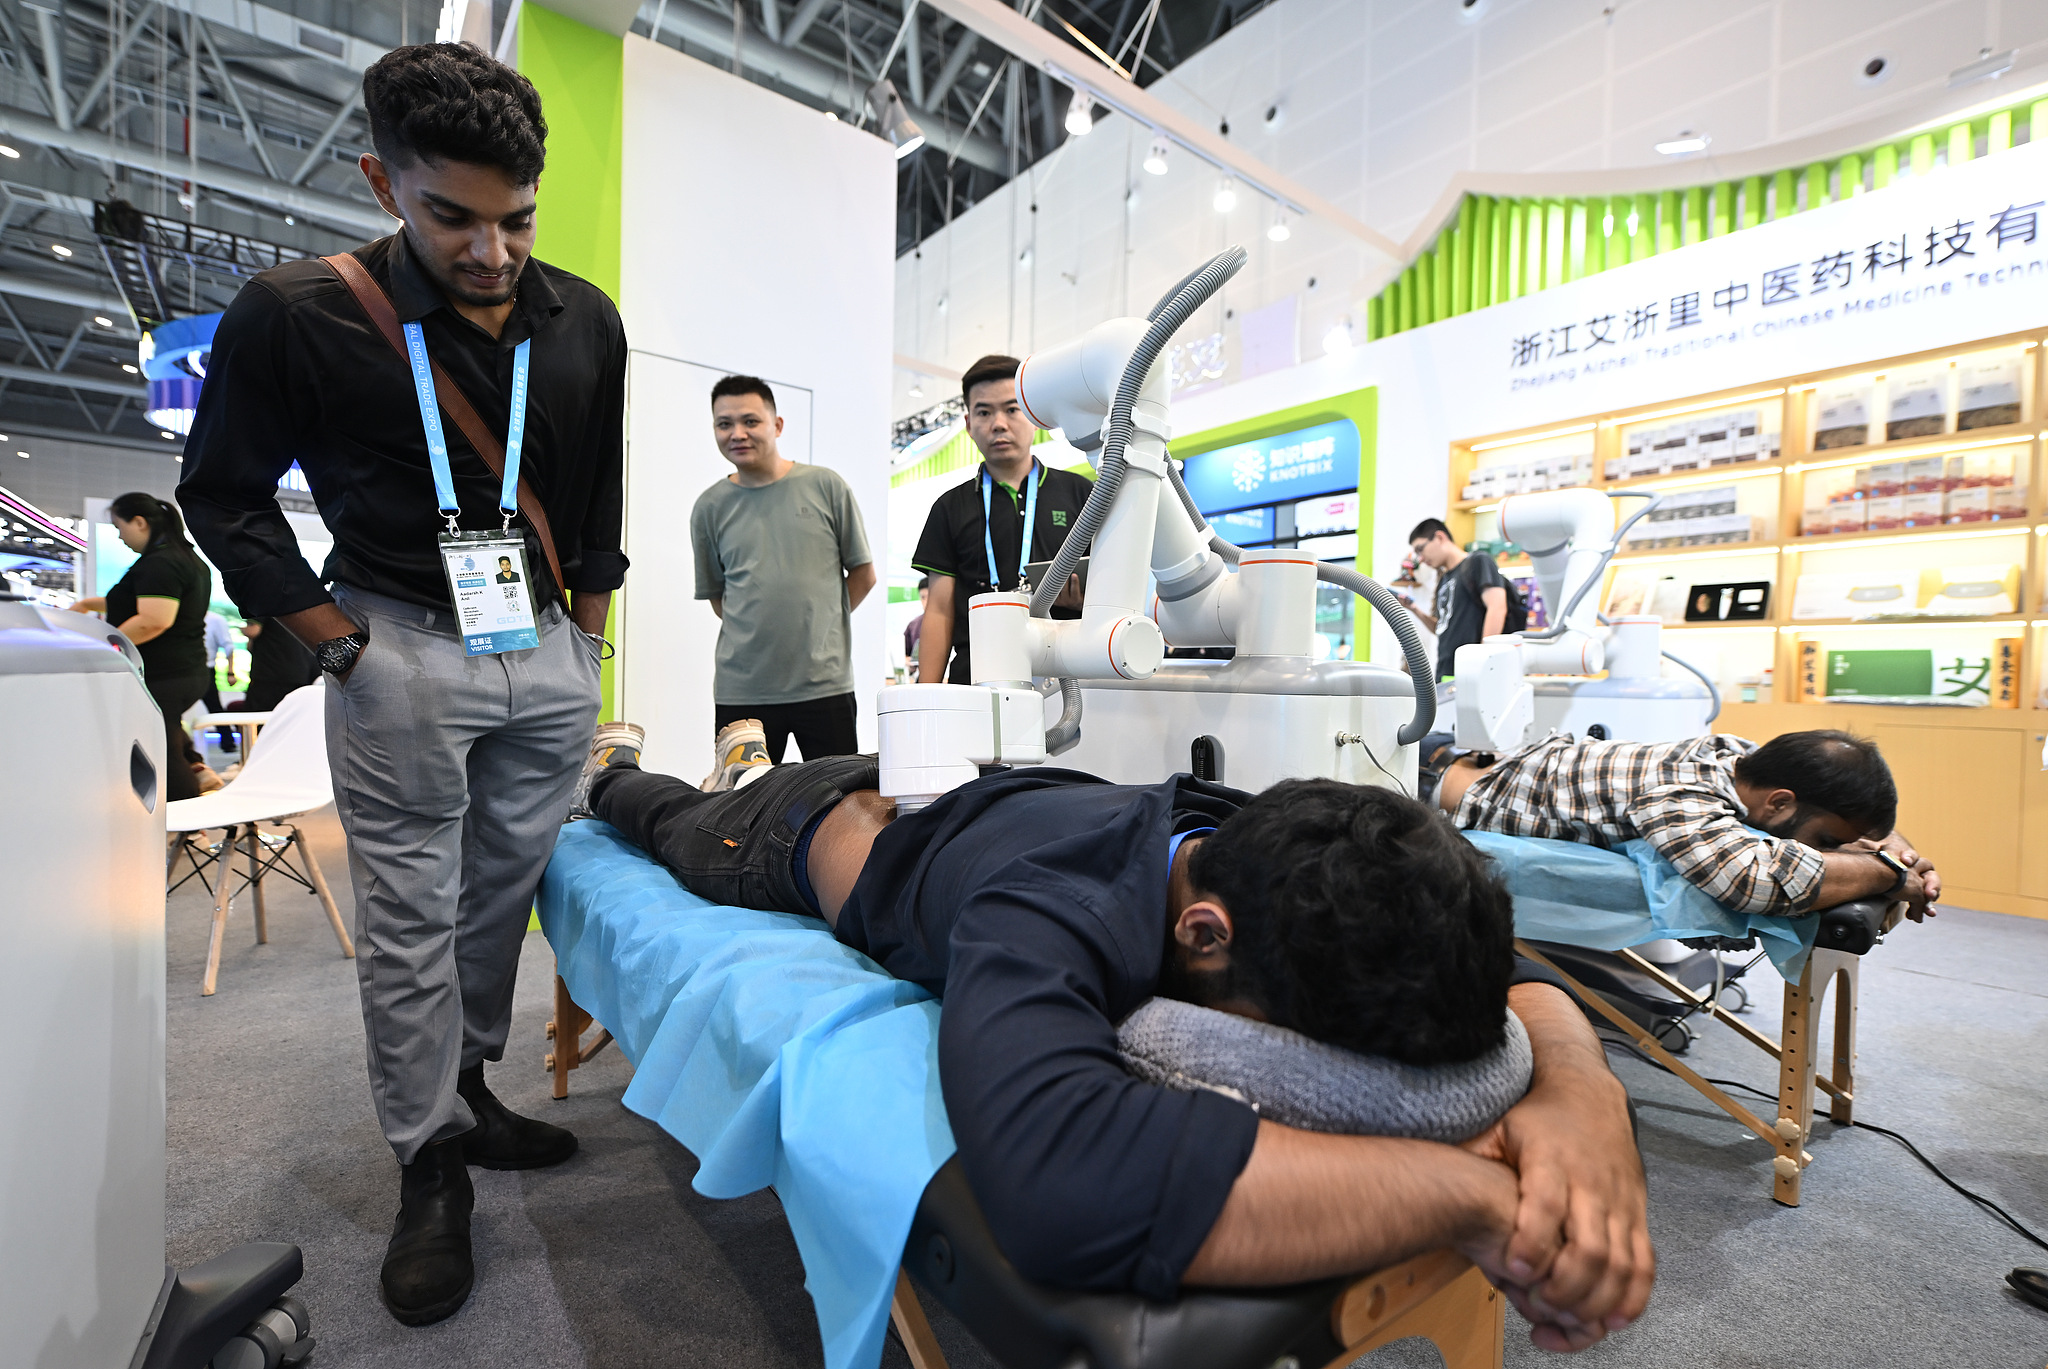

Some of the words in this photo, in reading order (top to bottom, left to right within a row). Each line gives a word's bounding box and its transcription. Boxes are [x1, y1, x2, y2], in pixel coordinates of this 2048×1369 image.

[1510, 200, 2046, 368] 浙江艾浙里中医药科技有
[1645, 326, 1745, 359] Traditional
[1752, 308, 1835, 337] Chinese
[1844, 278, 1952, 316] Medicine
[1963, 258, 2048, 290] Techn
[412, 341, 426, 375] DIGITAL
[420, 376, 432, 406] TRADE
[425, 407, 438, 431] EXPO
[1269, 458, 1334, 482] KNOTRIX
[470, 644, 494, 652] VISITOR
